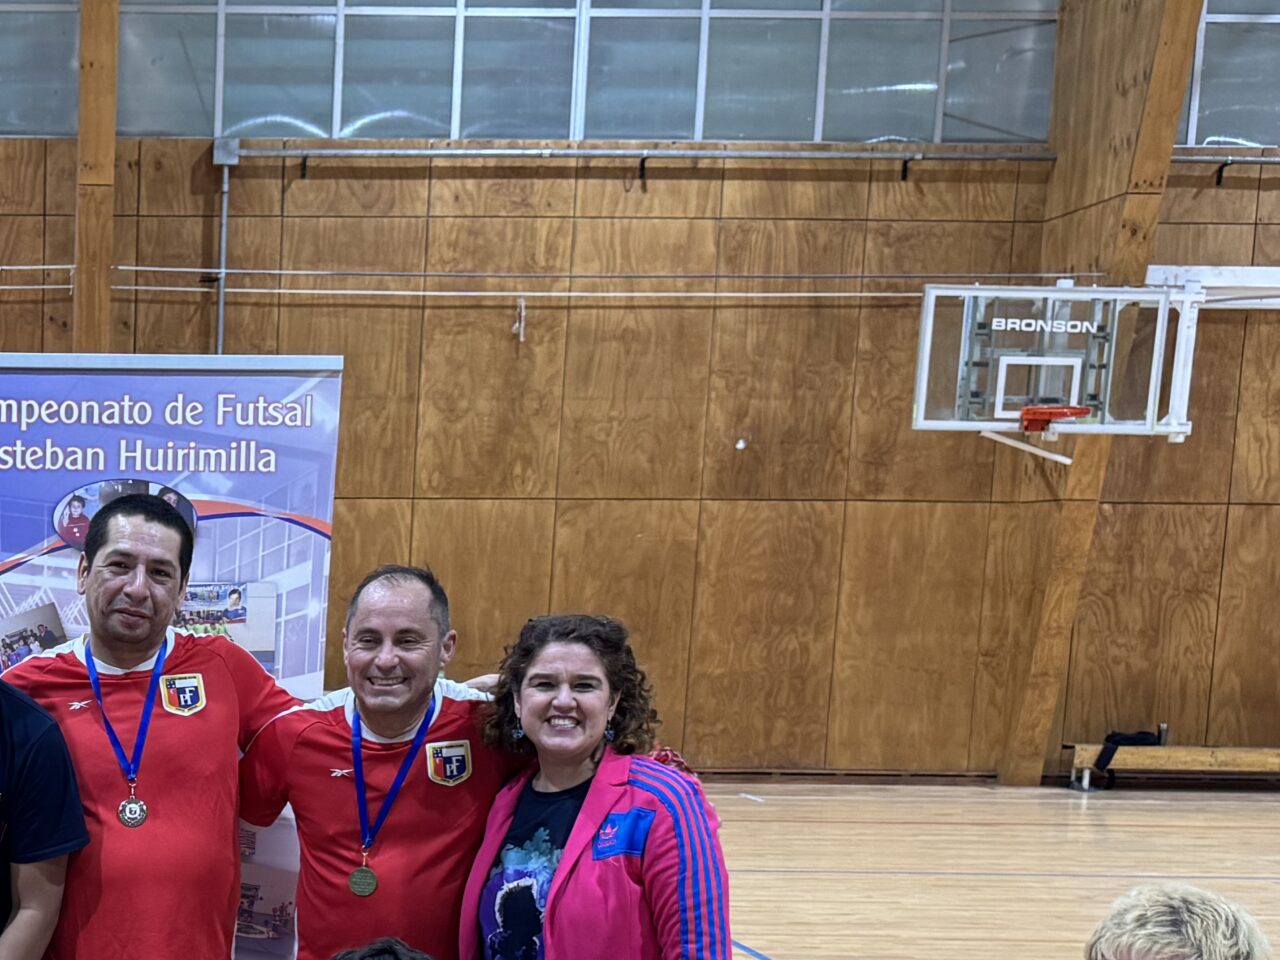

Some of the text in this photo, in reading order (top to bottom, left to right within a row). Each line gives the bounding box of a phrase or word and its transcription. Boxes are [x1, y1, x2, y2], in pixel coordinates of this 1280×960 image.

[991, 317, 1098, 334] BRONSON
[163, 394, 204, 427] de
[215, 393, 313, 429] Futsal
[119, 439, 277, 473] Huirimilla
